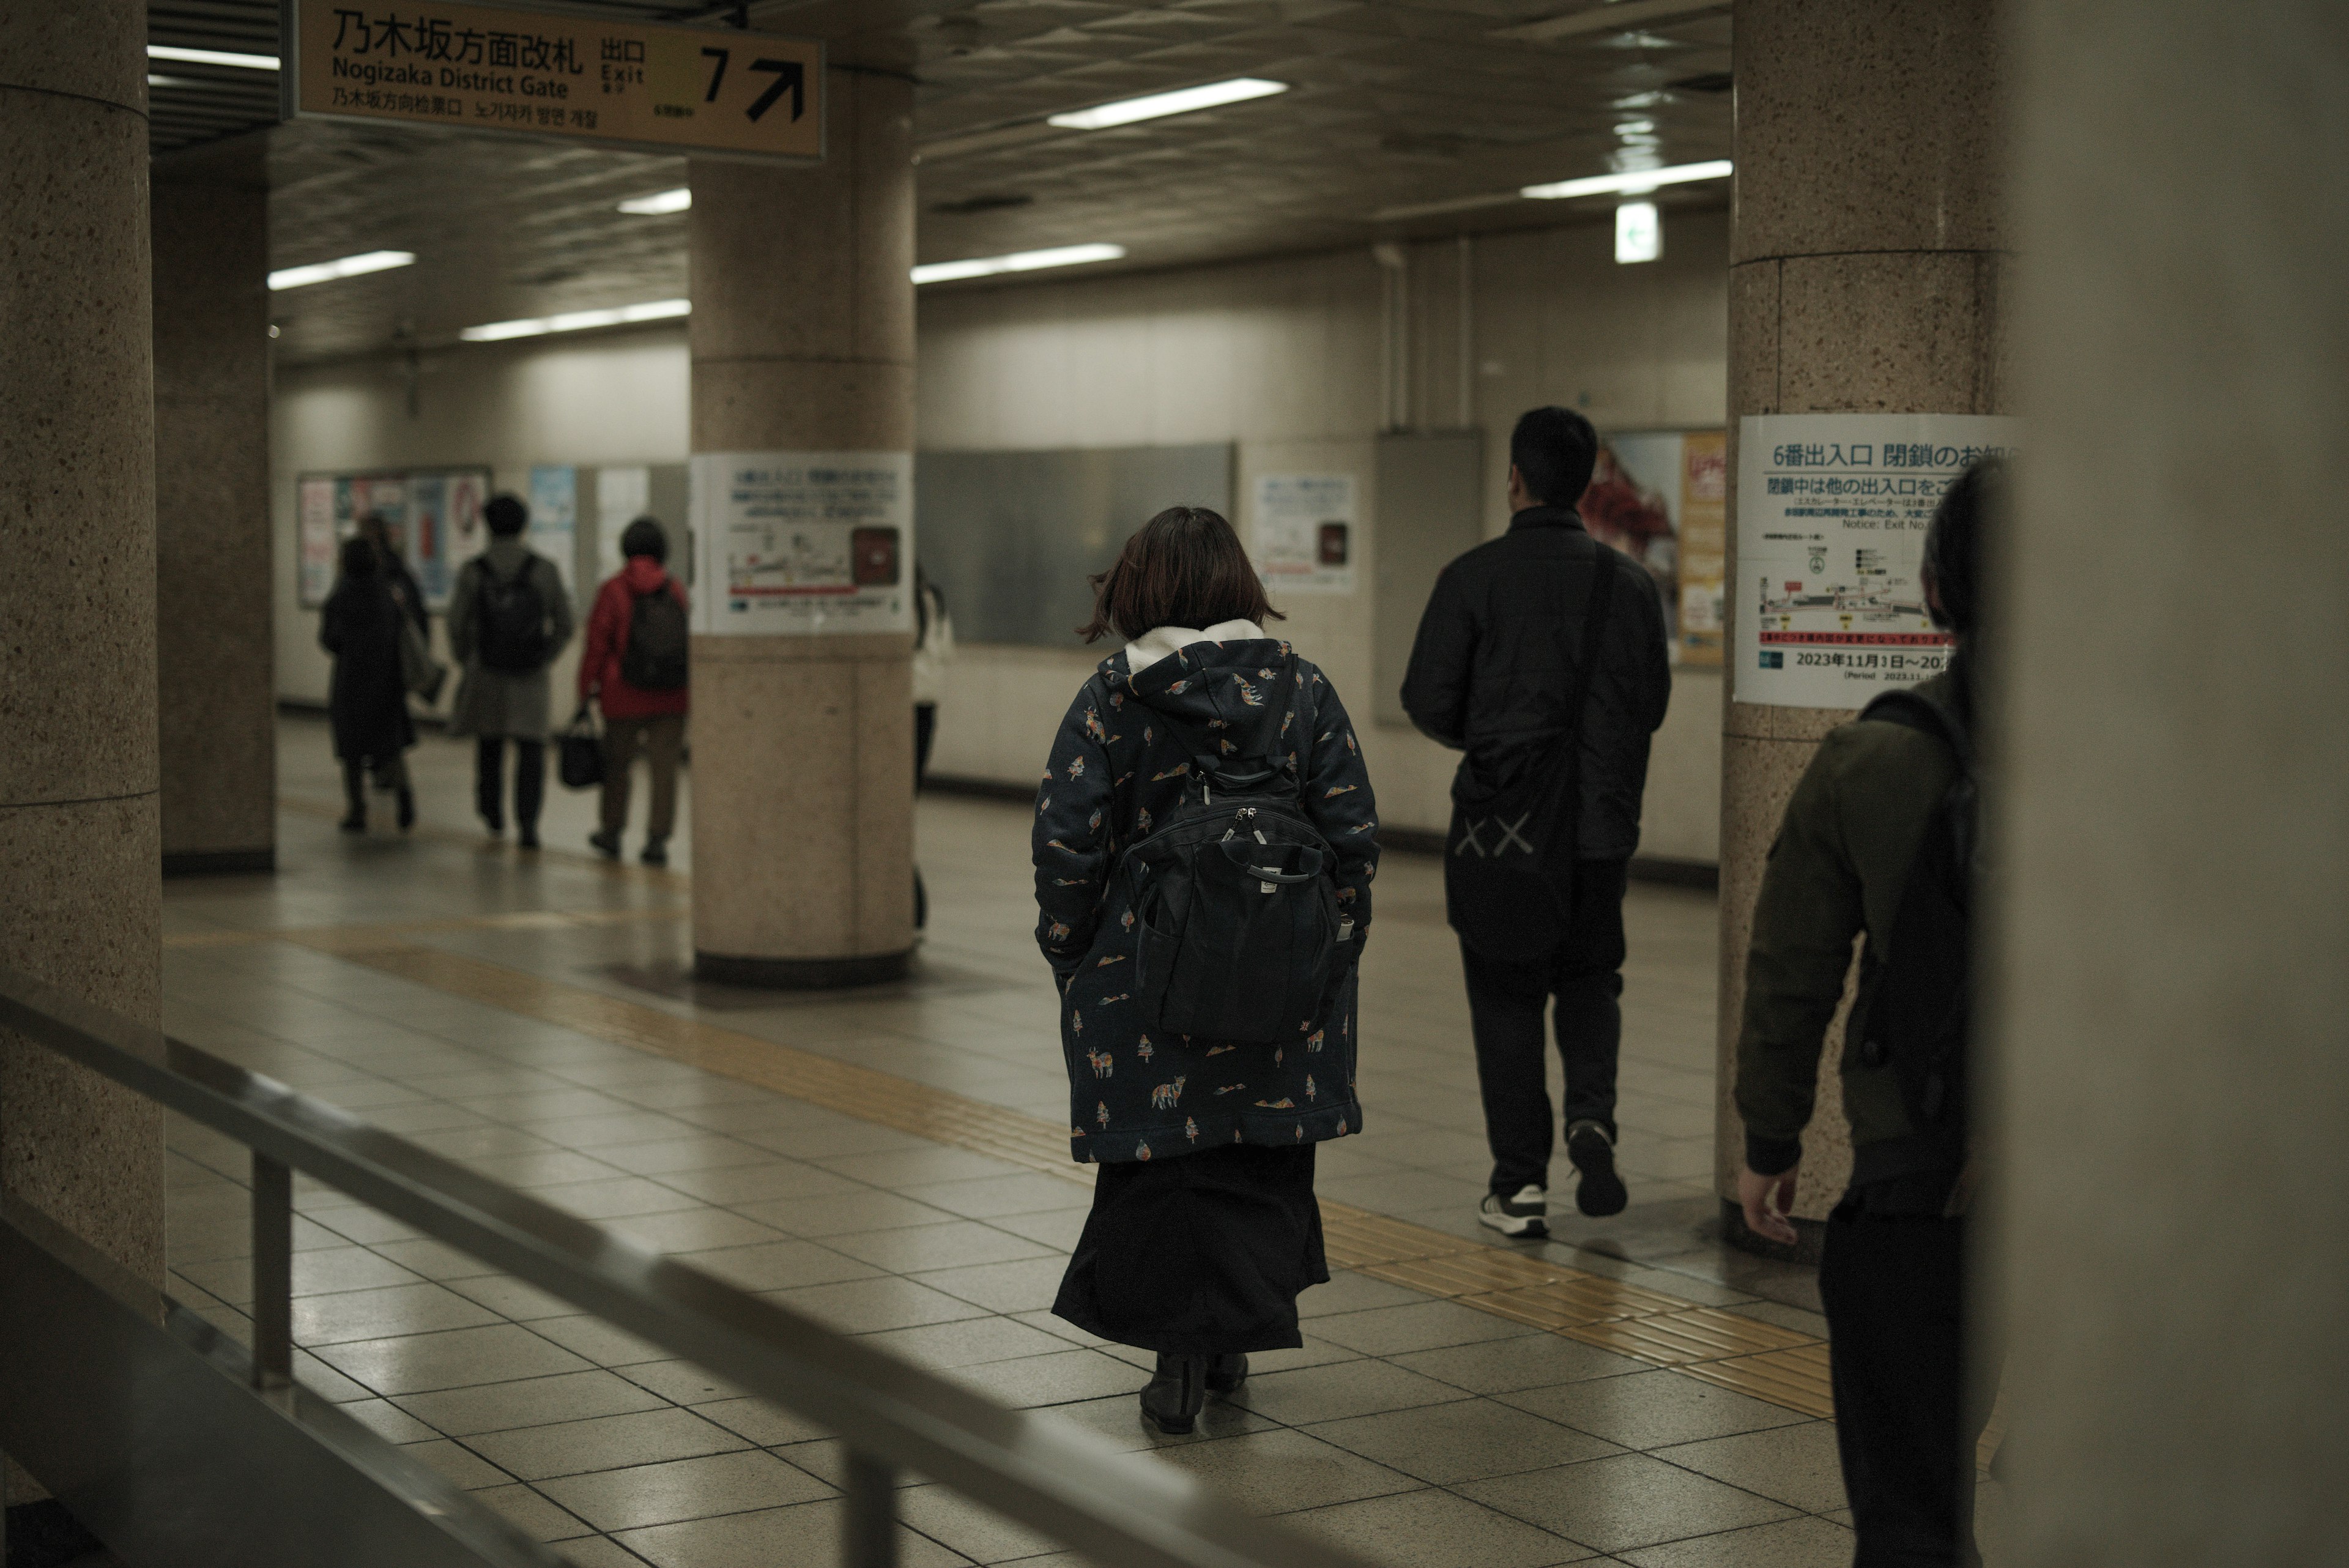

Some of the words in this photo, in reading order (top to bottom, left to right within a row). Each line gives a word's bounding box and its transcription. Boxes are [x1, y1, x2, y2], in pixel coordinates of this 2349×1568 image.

[333, 9, 583, 75] 乃木坂方面改札
[601, 37, 645, 63] 出口
[333, 56, 432, 86] Nogizaka
[440, 67, 513, 94] District
[521, 75, 569, 98] Gate
[601, 64, 644, 84] Exit
[701, 46, 729, 103] 7
[1773, 444, 1872, 467] 6番出入口
[1842, 519, 1880, 530] Notice:
[1885, 519, 1906, 530] Exit
